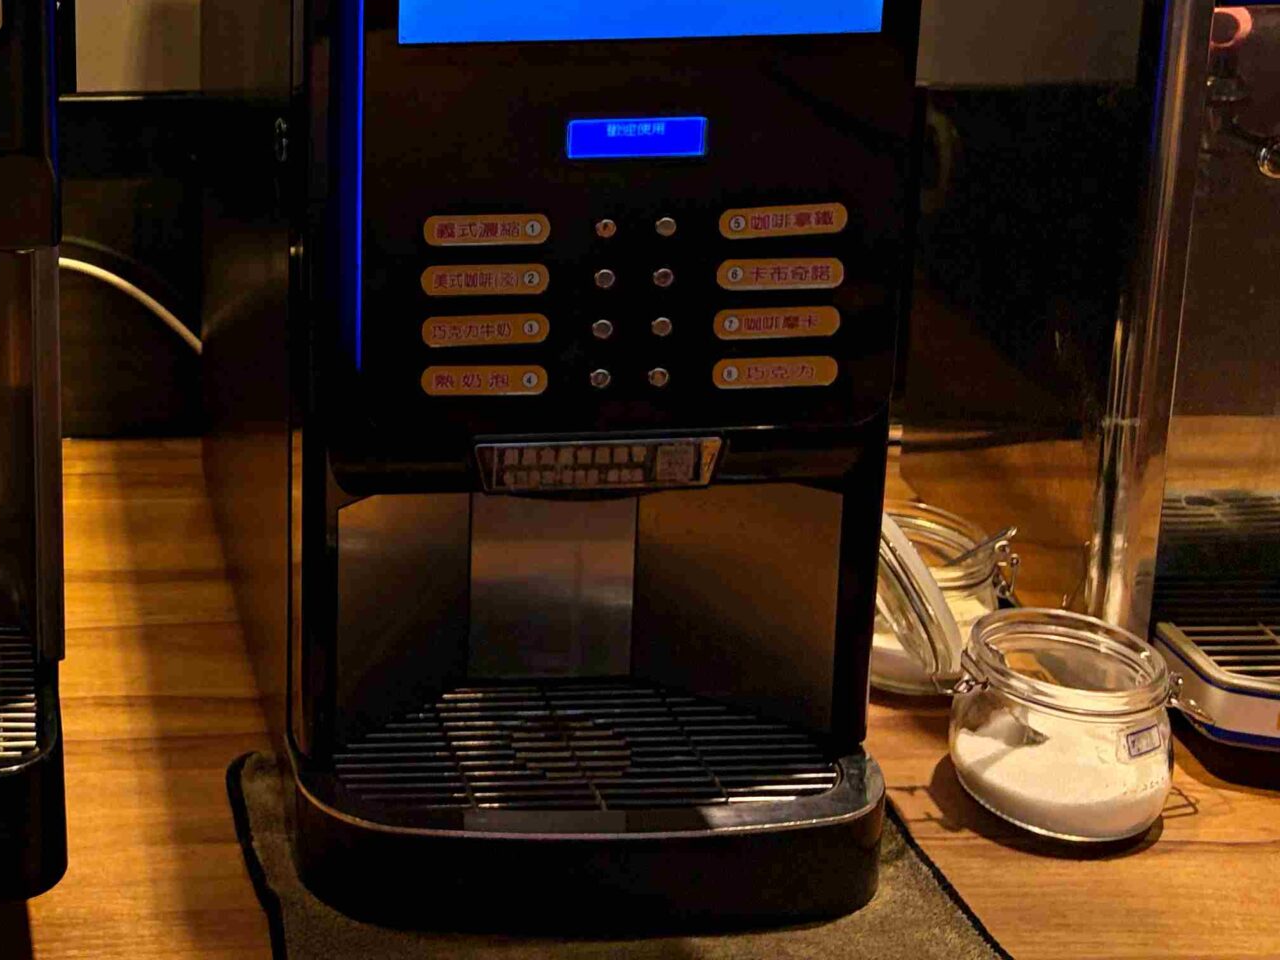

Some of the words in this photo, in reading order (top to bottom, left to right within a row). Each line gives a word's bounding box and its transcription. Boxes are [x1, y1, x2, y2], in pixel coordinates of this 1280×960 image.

[751, 209, 834, 231] 咖啡拿鐵
[750, 264, 831, 283] 卡布奇諾
[432, 320, 512, 340] 巧克力牛奶
[746, 364, 815, 381] 巧克力
